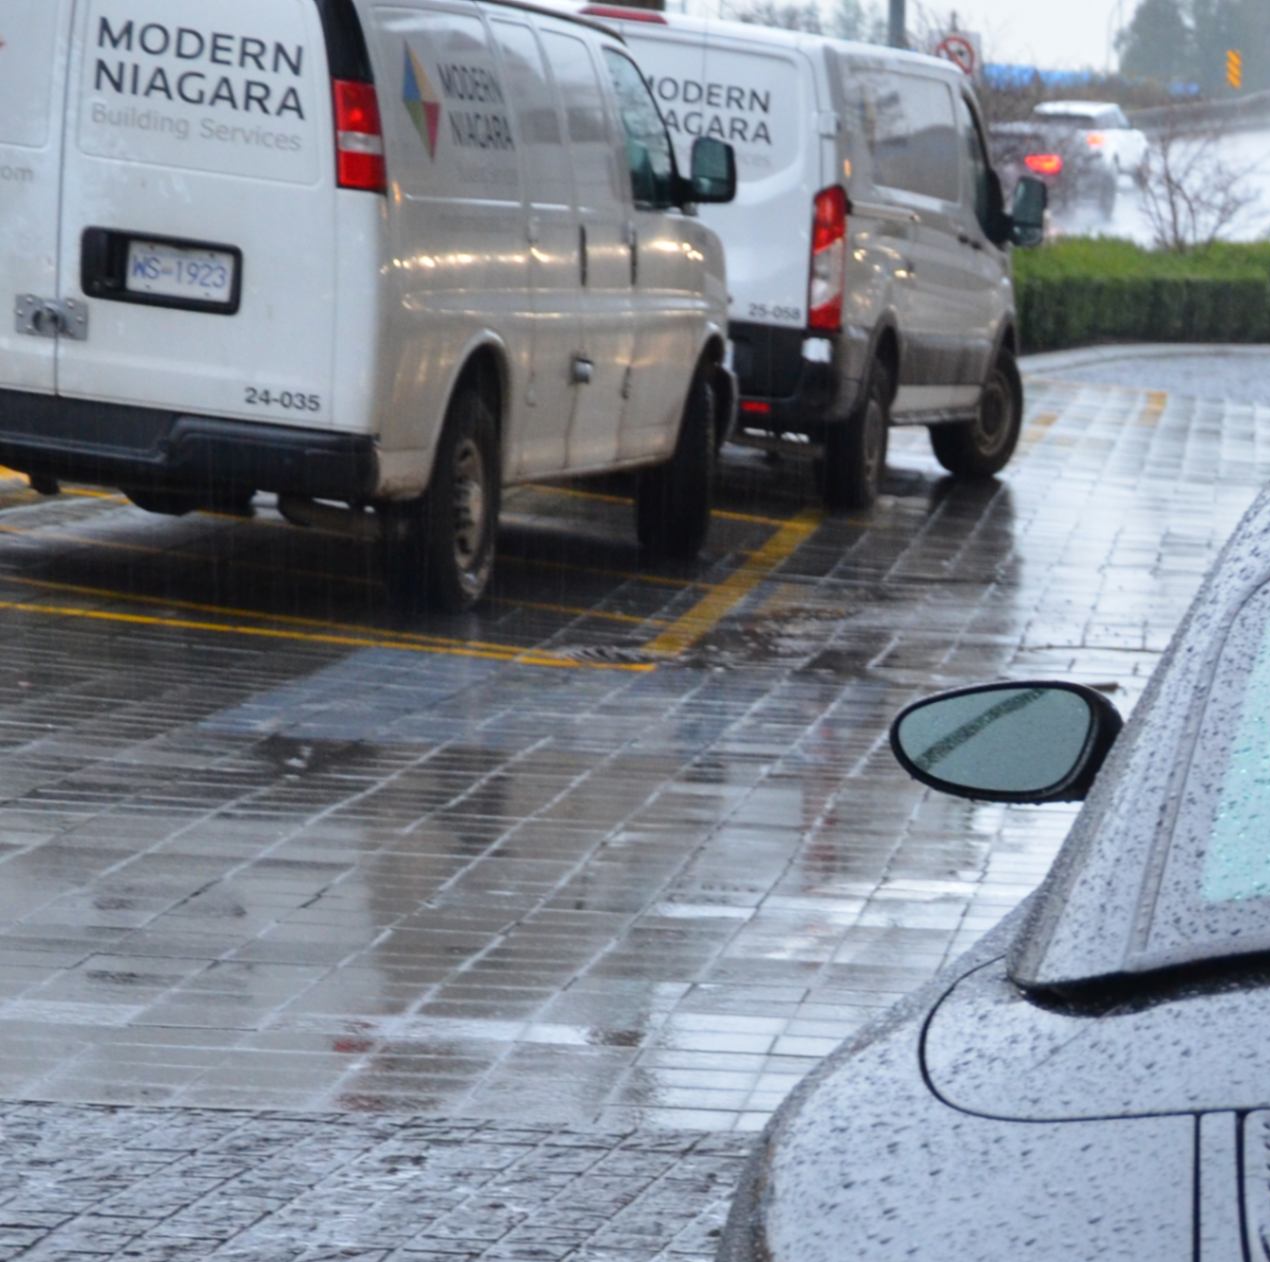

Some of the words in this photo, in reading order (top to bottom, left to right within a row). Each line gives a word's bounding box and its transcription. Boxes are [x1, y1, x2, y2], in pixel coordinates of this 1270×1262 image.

[98, 16, 304, 77] MODERN
[94, 58, 305, 120] NIAGARA
[437, 63, 505, 104] MODERN
[91, 103, 190, 141] Building
[200, 118, 303, 151] Services
[449, 111, 516, 151] NIAGARA
[244, 387, 321, 412] 24-035
